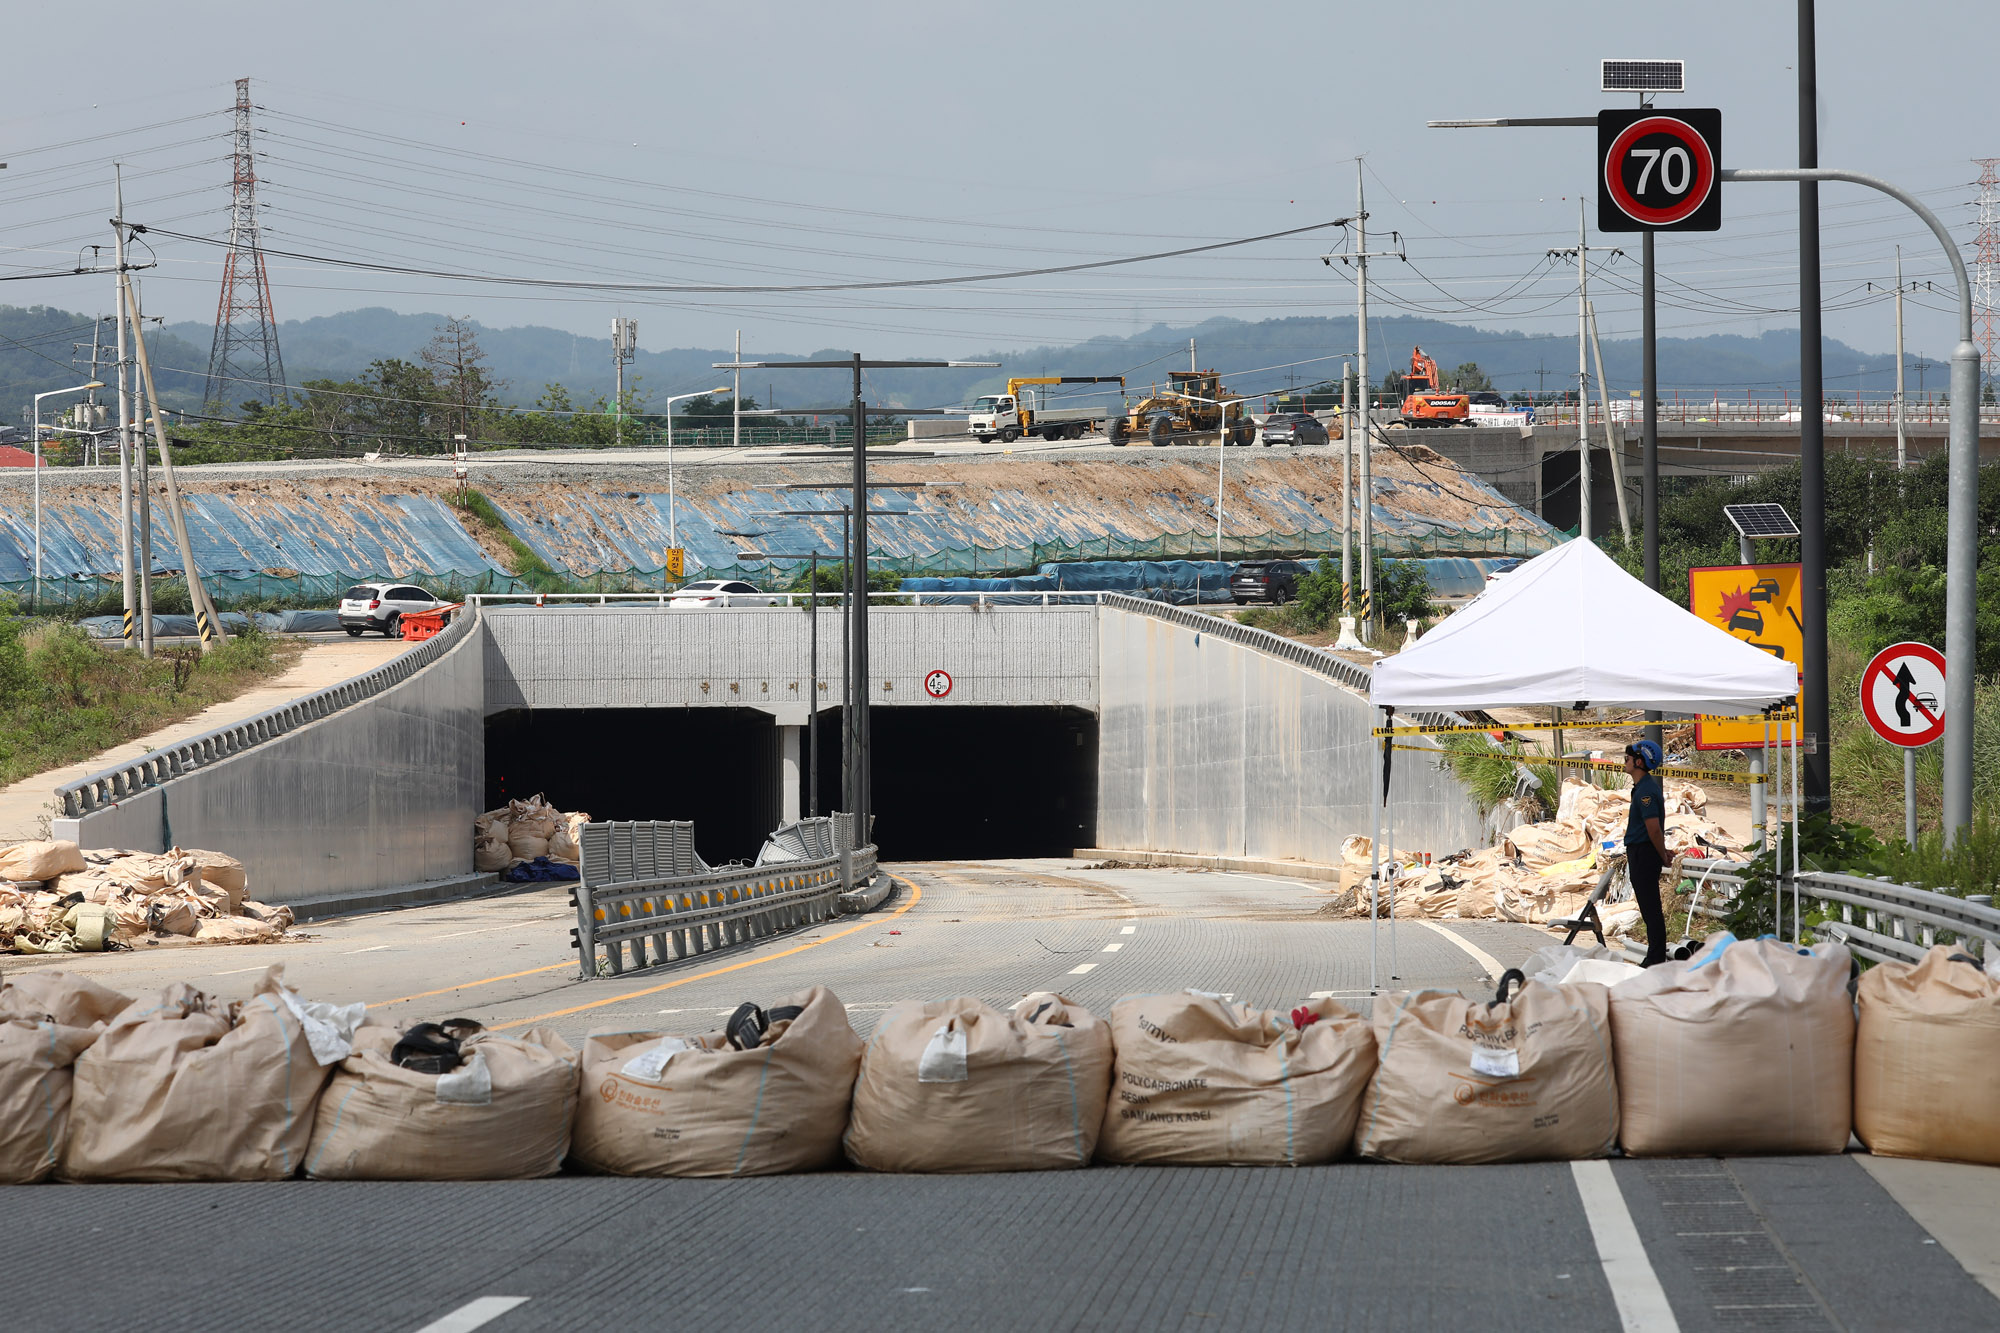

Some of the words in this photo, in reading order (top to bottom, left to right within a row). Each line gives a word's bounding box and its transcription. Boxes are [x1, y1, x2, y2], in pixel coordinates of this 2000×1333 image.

[1630, 146, 1691, 195] 70
[1122, 1071, 1208, 1092] POLYCARBONATE
[1121, 1090, 1151, 1105] RESIN
[1120, 1109, 1174, 1124] SAMYANG
[1176, 1109, 1211, 1123] KASEI
